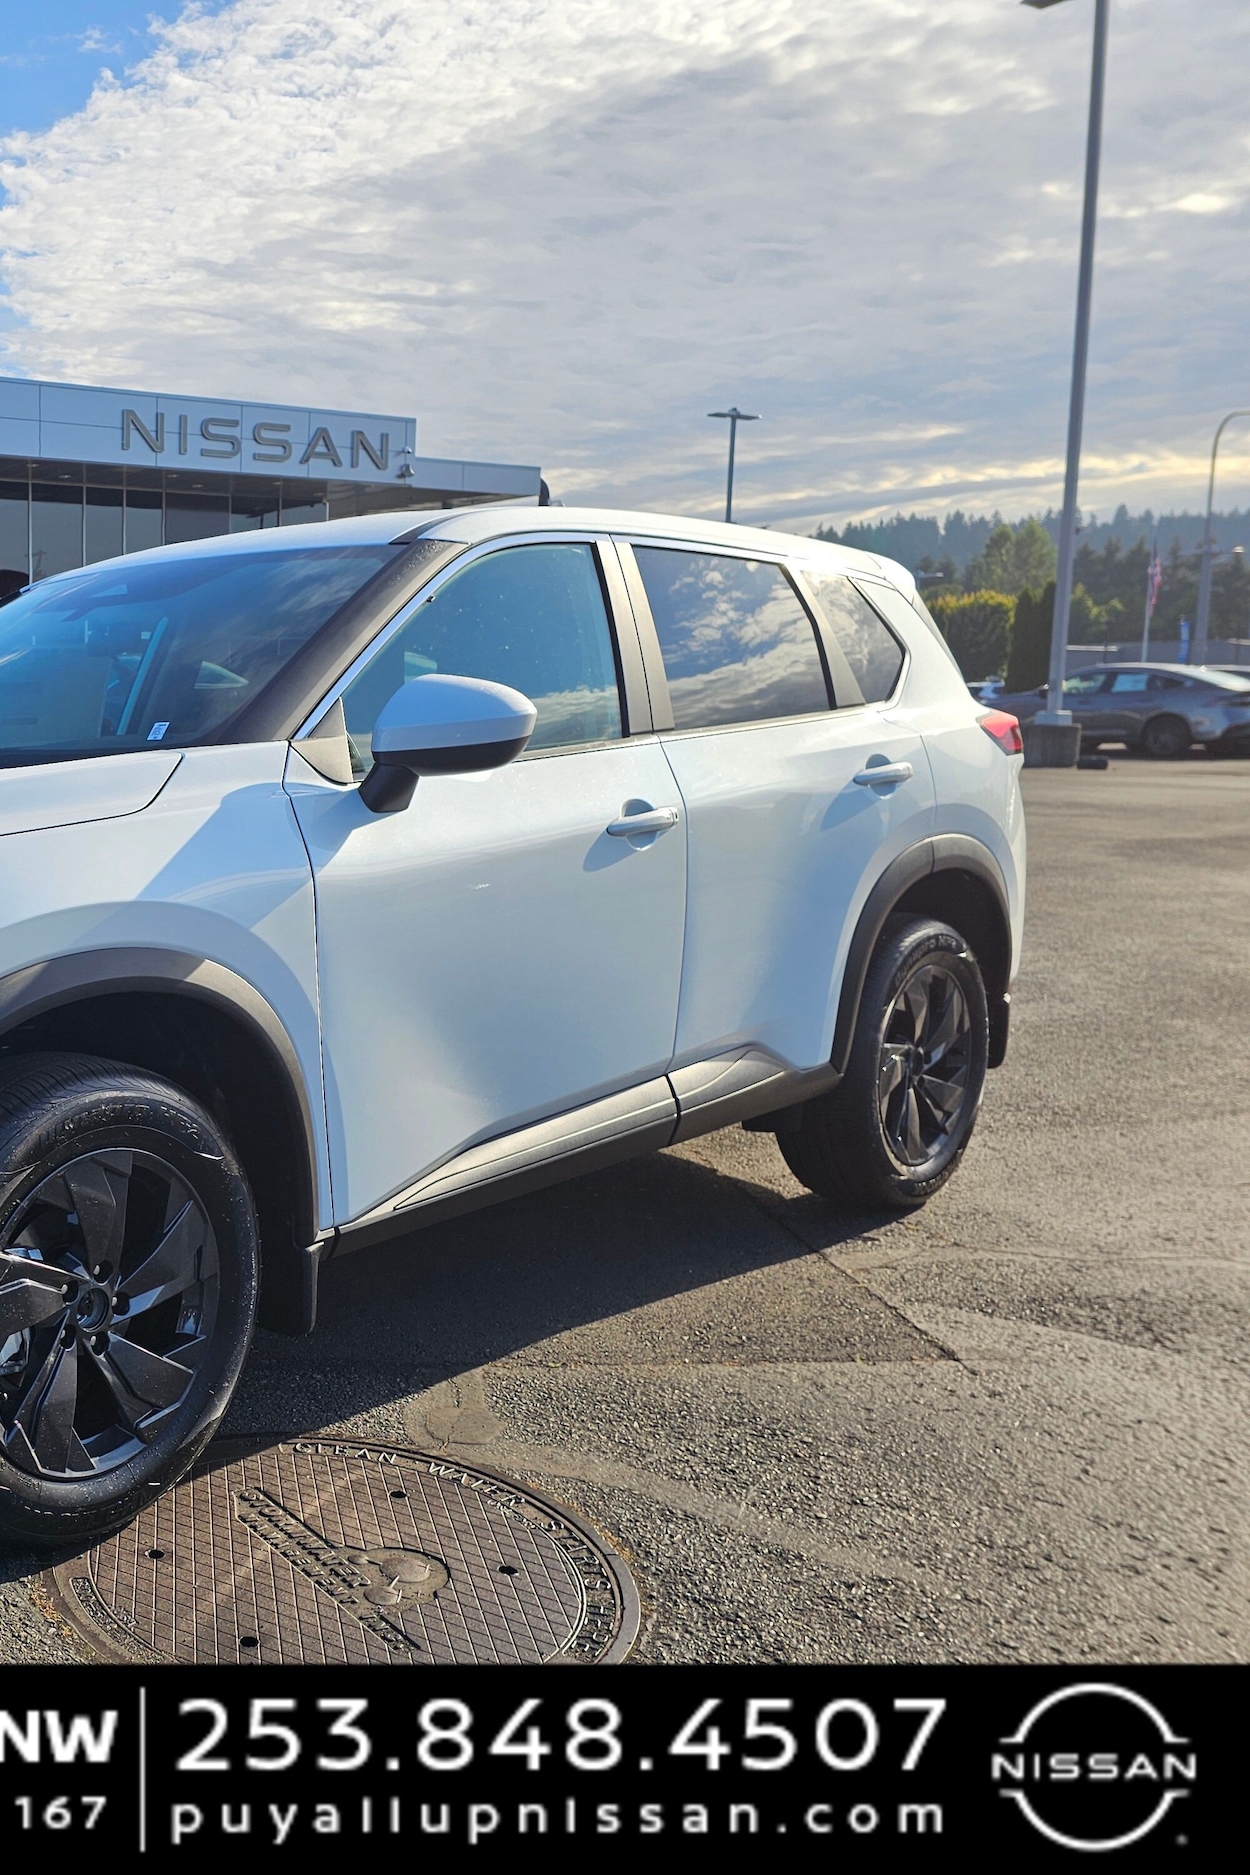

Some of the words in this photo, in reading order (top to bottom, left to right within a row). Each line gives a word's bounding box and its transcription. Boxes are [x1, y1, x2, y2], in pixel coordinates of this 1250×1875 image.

[121, 408, 390, 471] NISSAN
[293, 1442, 397, 1465] CLEAN
[428, 1462, 526, 1508] WATER
[540, 1520, 612, 1590] STARTS
